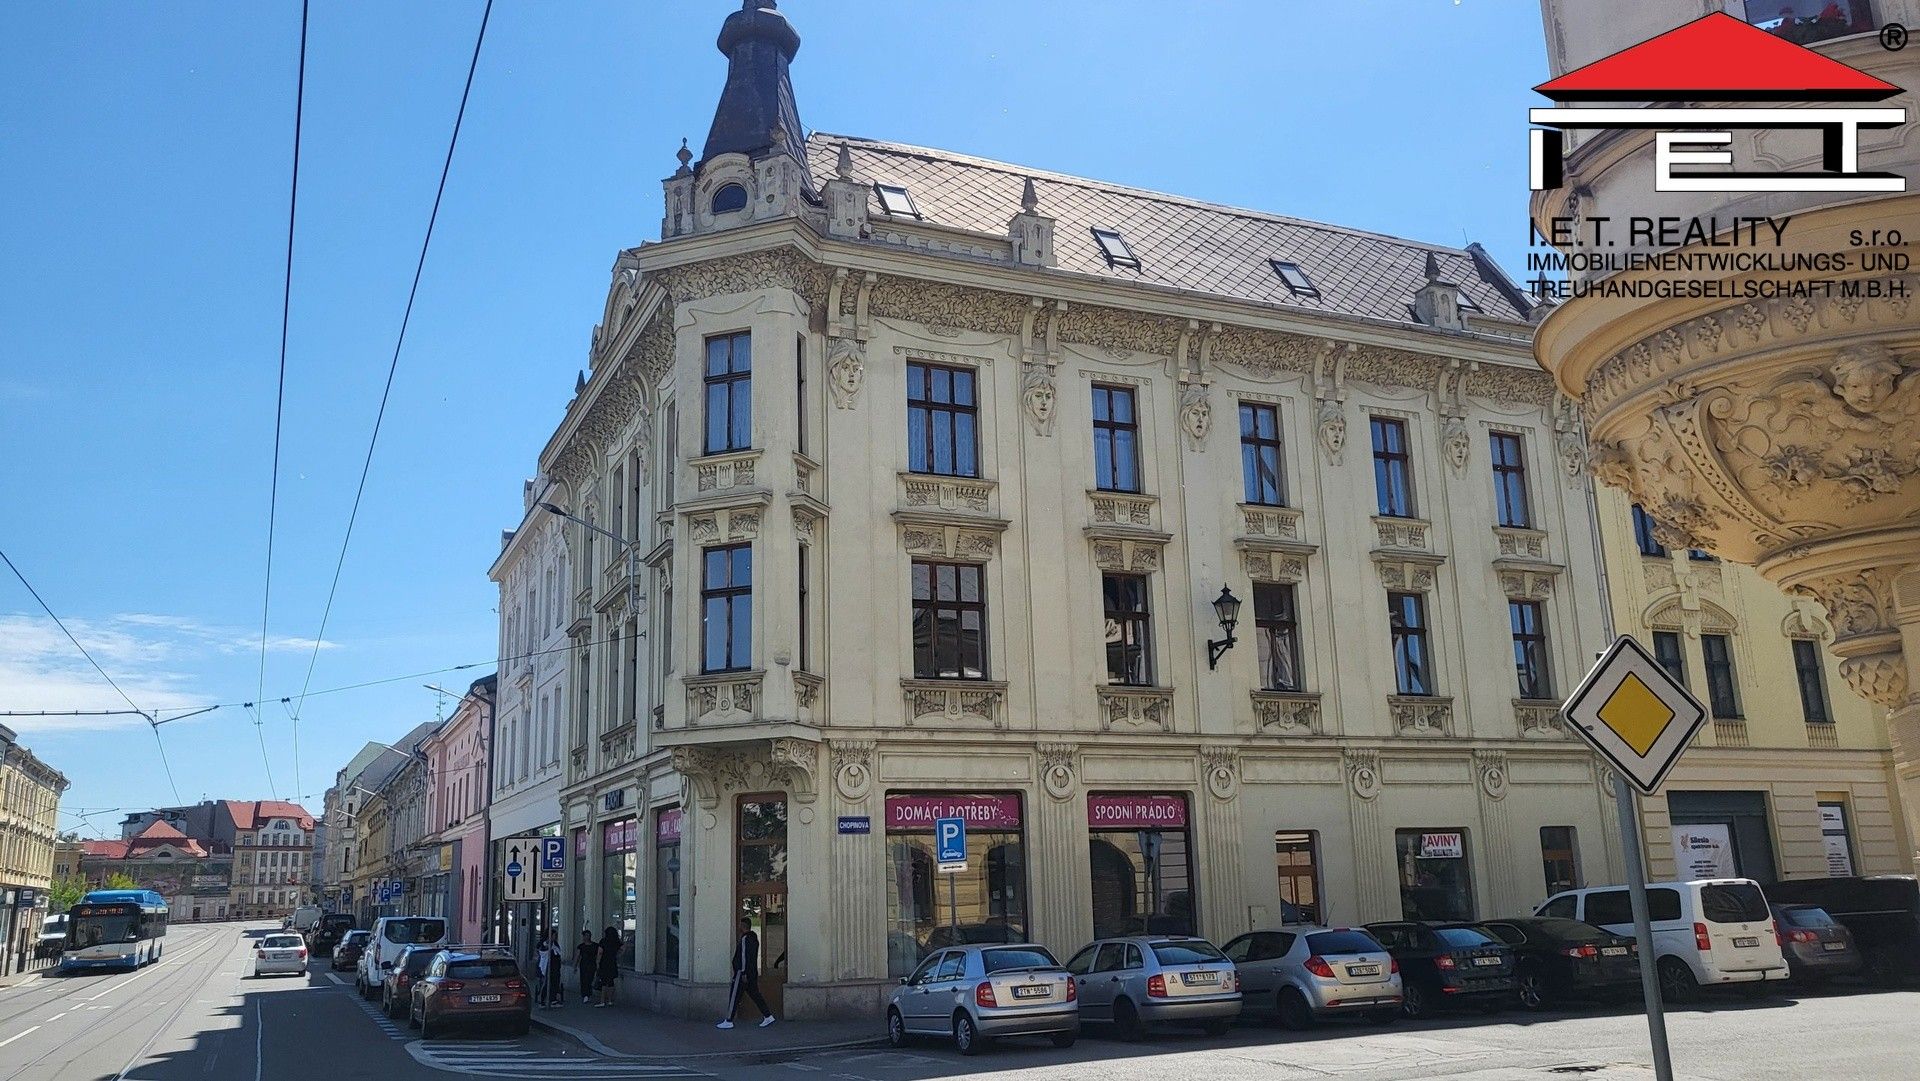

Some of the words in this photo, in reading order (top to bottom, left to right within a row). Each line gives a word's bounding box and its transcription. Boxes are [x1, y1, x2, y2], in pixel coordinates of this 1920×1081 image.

[896, 801, 943, 821] DOMÁCÍ
[949, 801, 997, 821] POTŘEBY
[1095, 801, 1133, 820] SPODNÍ
[1135, 801, 1175, 820] PRÁDLO
[839, 821, 869, 830] CHOPINOVA
[942, 823, 959, 848] P
[547, 840, 561, 861] P
[382, 889, 390, 898] P
[393, 882, 401, 893] P
